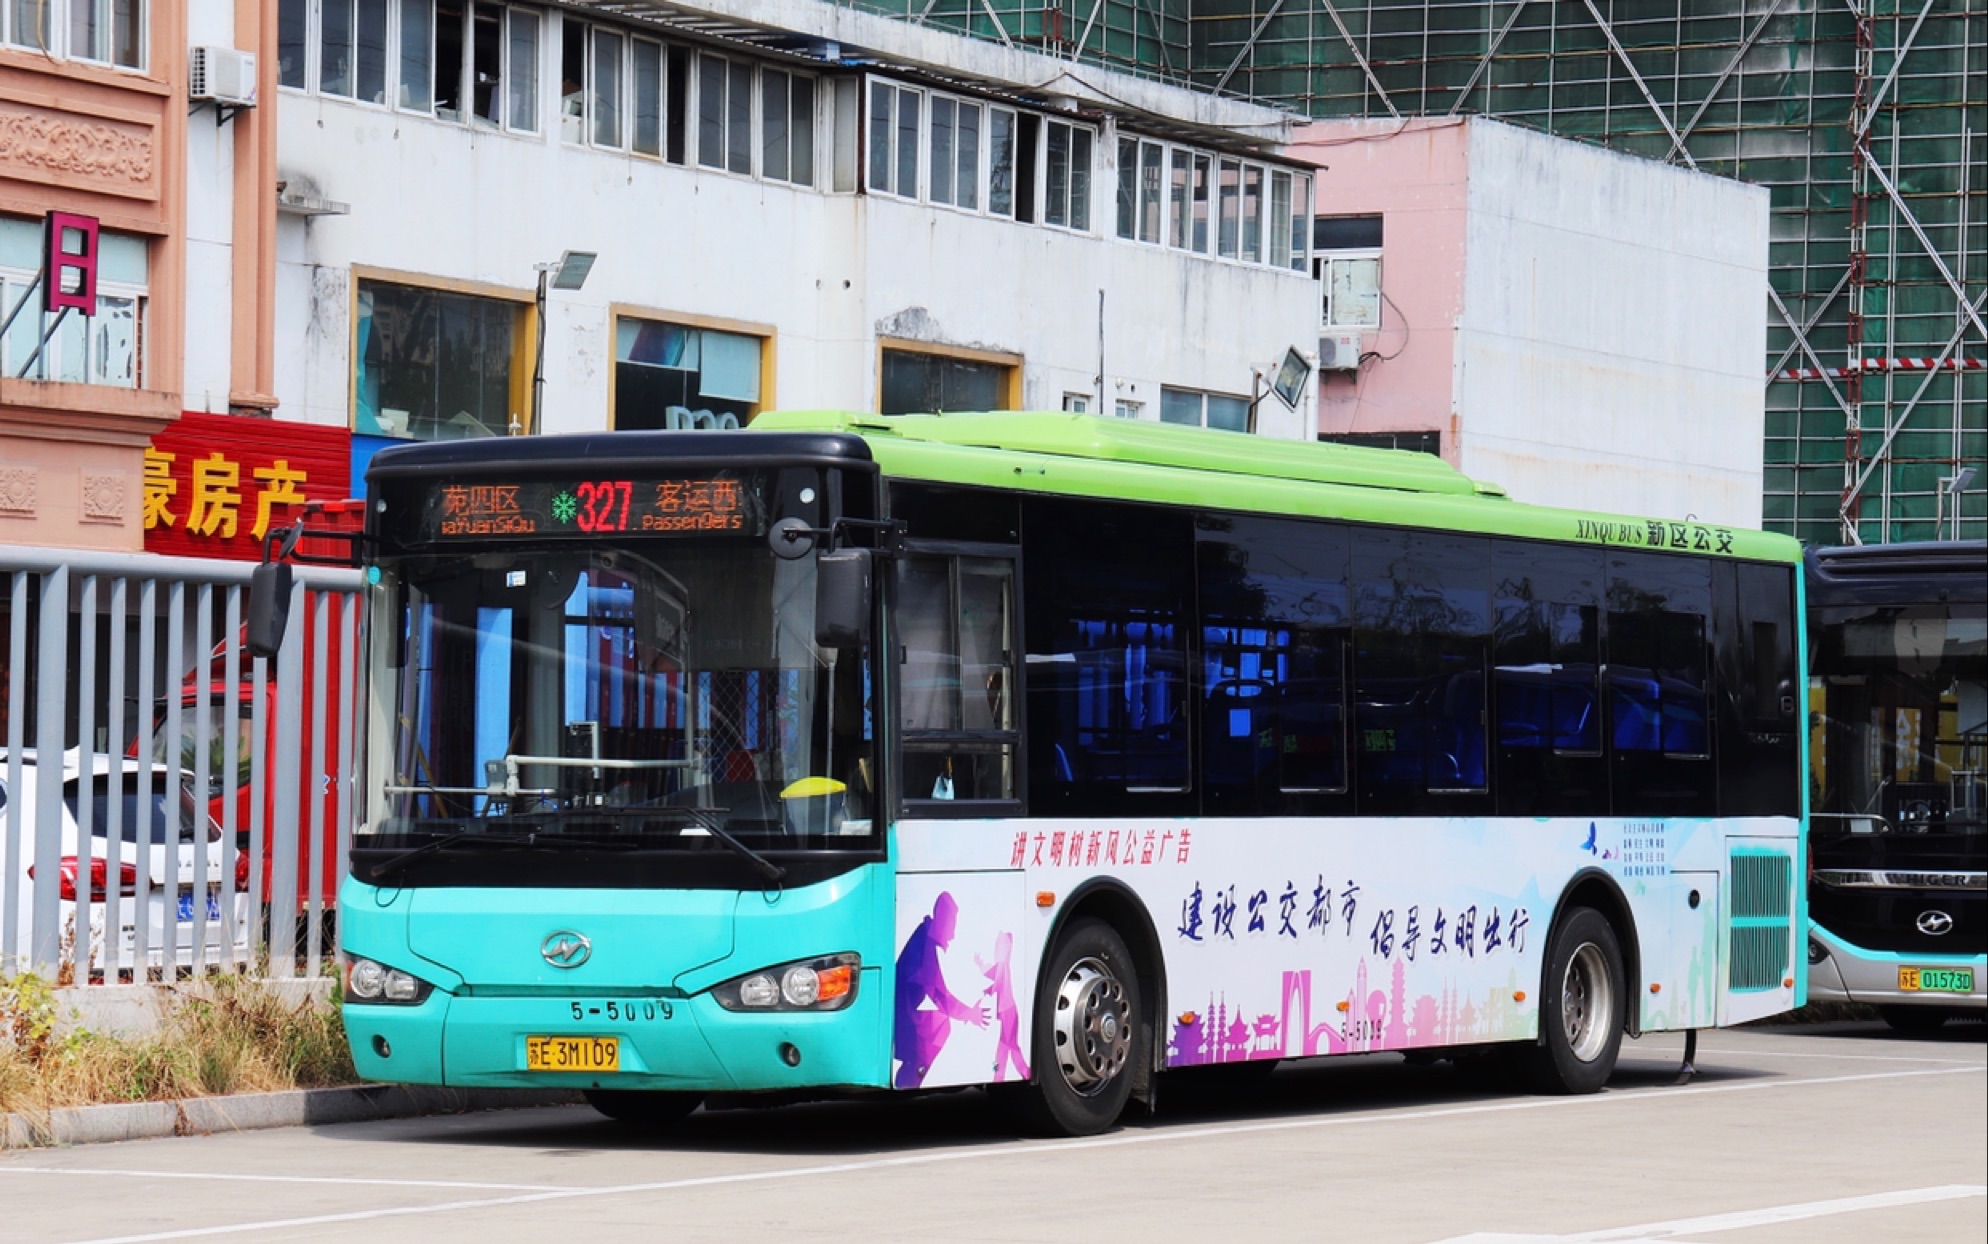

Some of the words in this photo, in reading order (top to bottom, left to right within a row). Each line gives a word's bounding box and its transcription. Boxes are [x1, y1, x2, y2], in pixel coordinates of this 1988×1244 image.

[577, 481, 632, 531] 327
[656, 480, 743, 512] 客运西
[1576, 519, 1617, 544] XINQU
[1618, 522, 1643, 544] BUS
[1646, 520, 1734, 554] 新区公交
[1010, 828, 1191, 868] 讲文明树新风公益广告
[1178, 874, 1362, 940] 建设公交都市
[1369, 905, 1531, 961] 倡导文明出行
[571, 1001, 673, 1022] 5-5009
